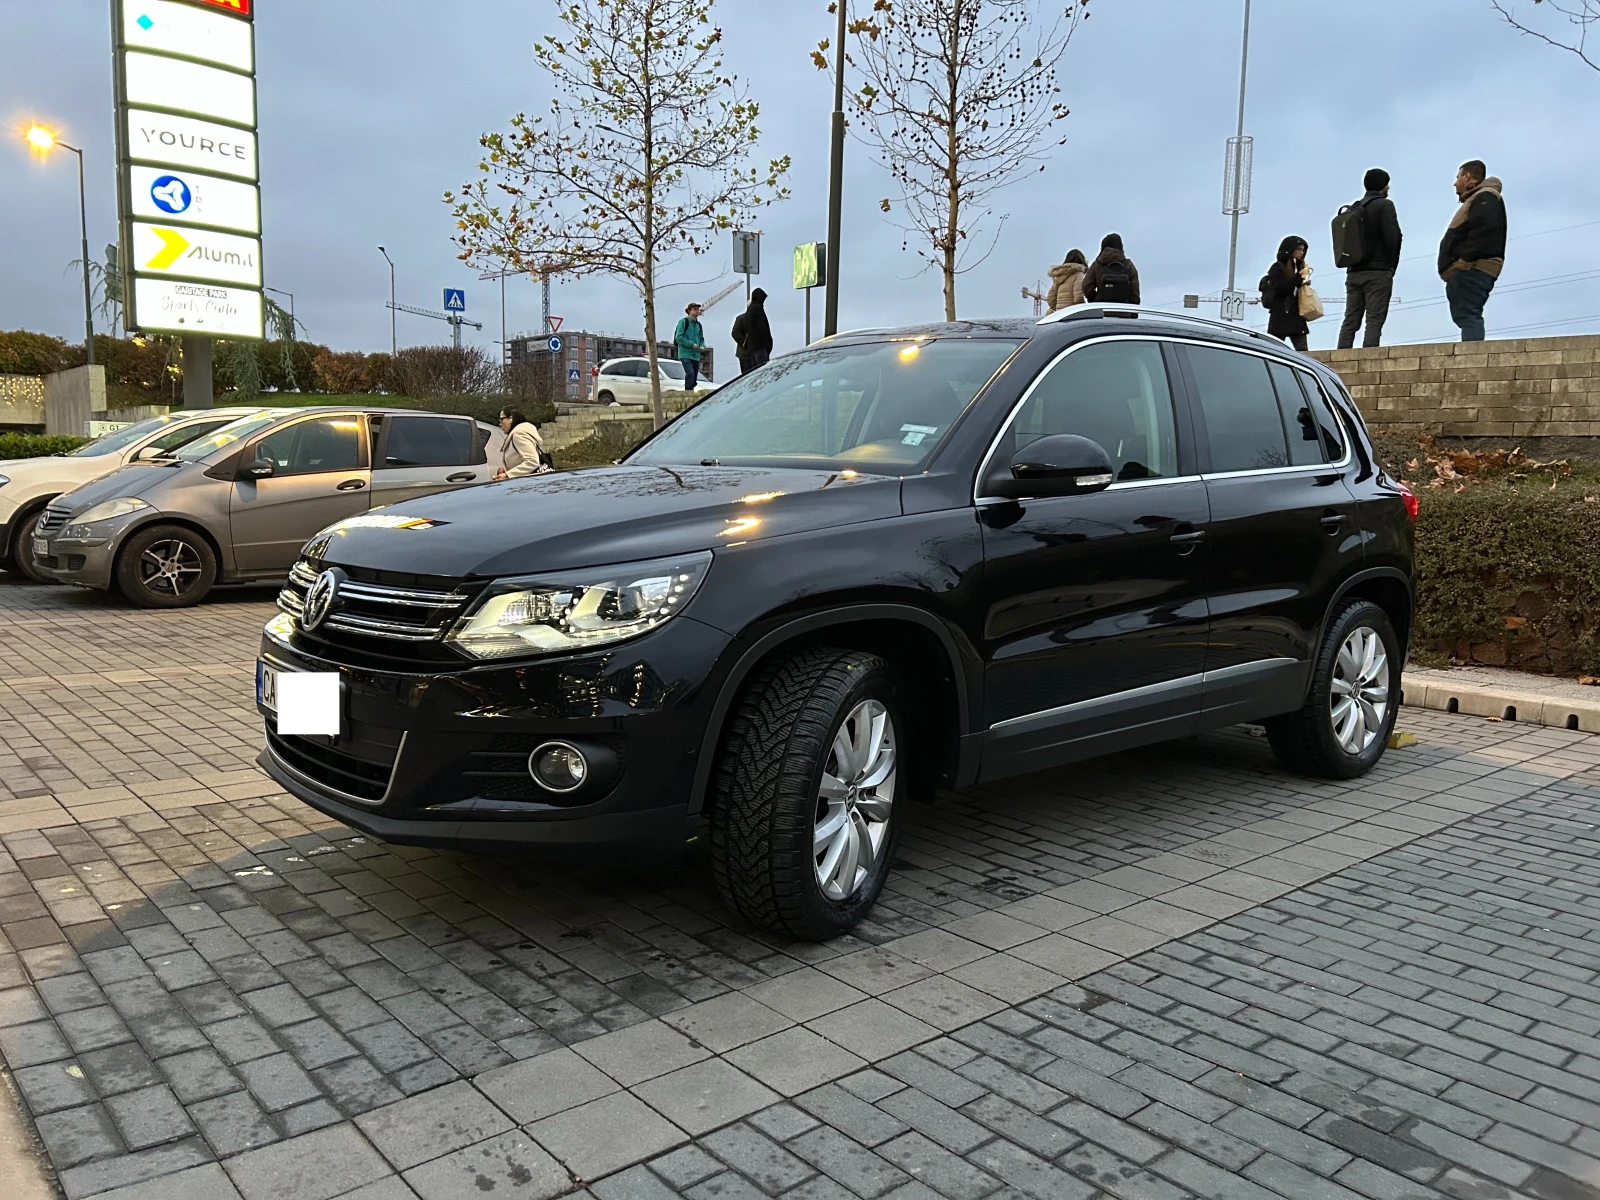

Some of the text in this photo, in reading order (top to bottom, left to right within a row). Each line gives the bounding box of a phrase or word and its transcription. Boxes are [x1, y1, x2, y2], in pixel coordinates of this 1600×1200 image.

[140, 128, 246, 160] YOURCE
[187, 246, 252, 267] Alumil
[210, 290, 227, 298] PARK
